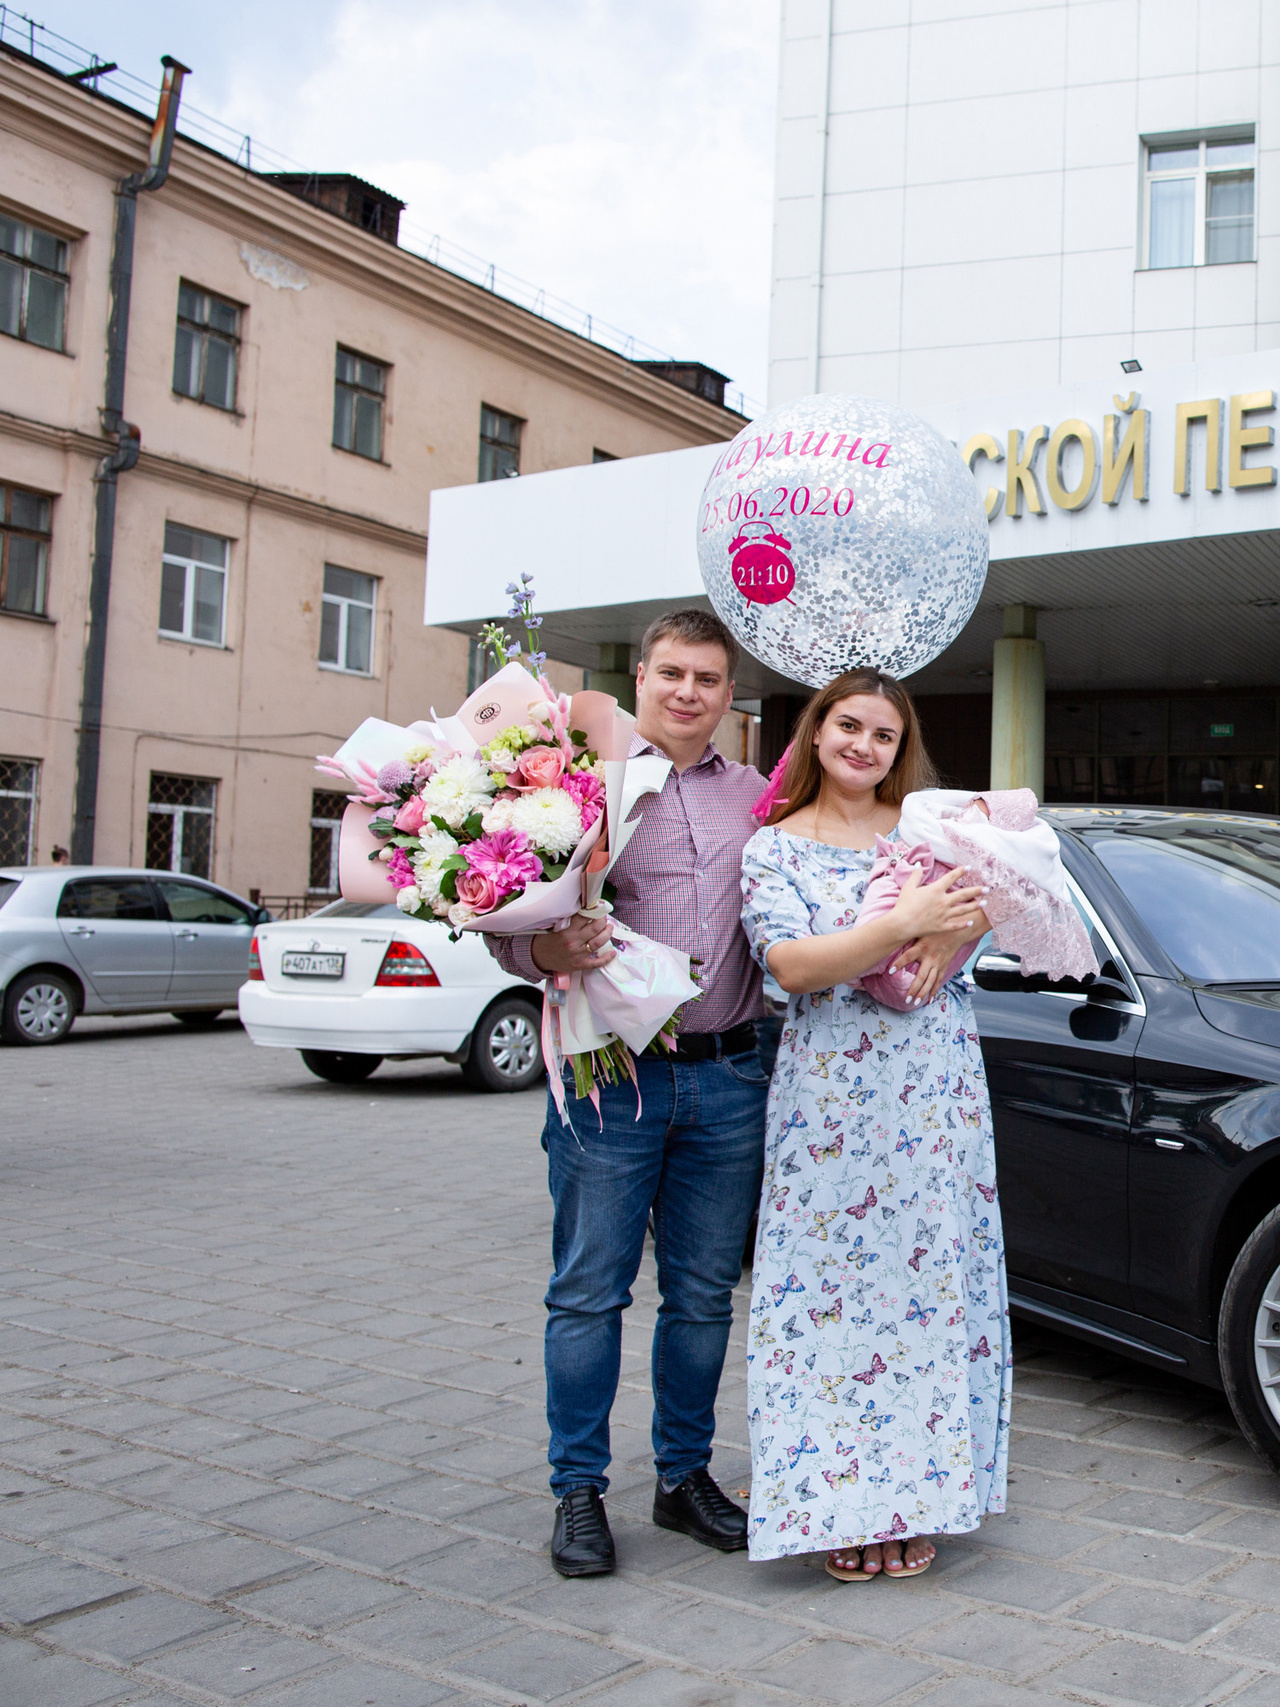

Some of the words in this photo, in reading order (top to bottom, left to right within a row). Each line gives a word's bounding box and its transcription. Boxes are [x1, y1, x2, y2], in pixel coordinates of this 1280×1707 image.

[962, 391, 1152, 520] СКОЙ
[702, 486, 854, 533] 25.06.2020
[737, 564, 789, 586] 21:10
